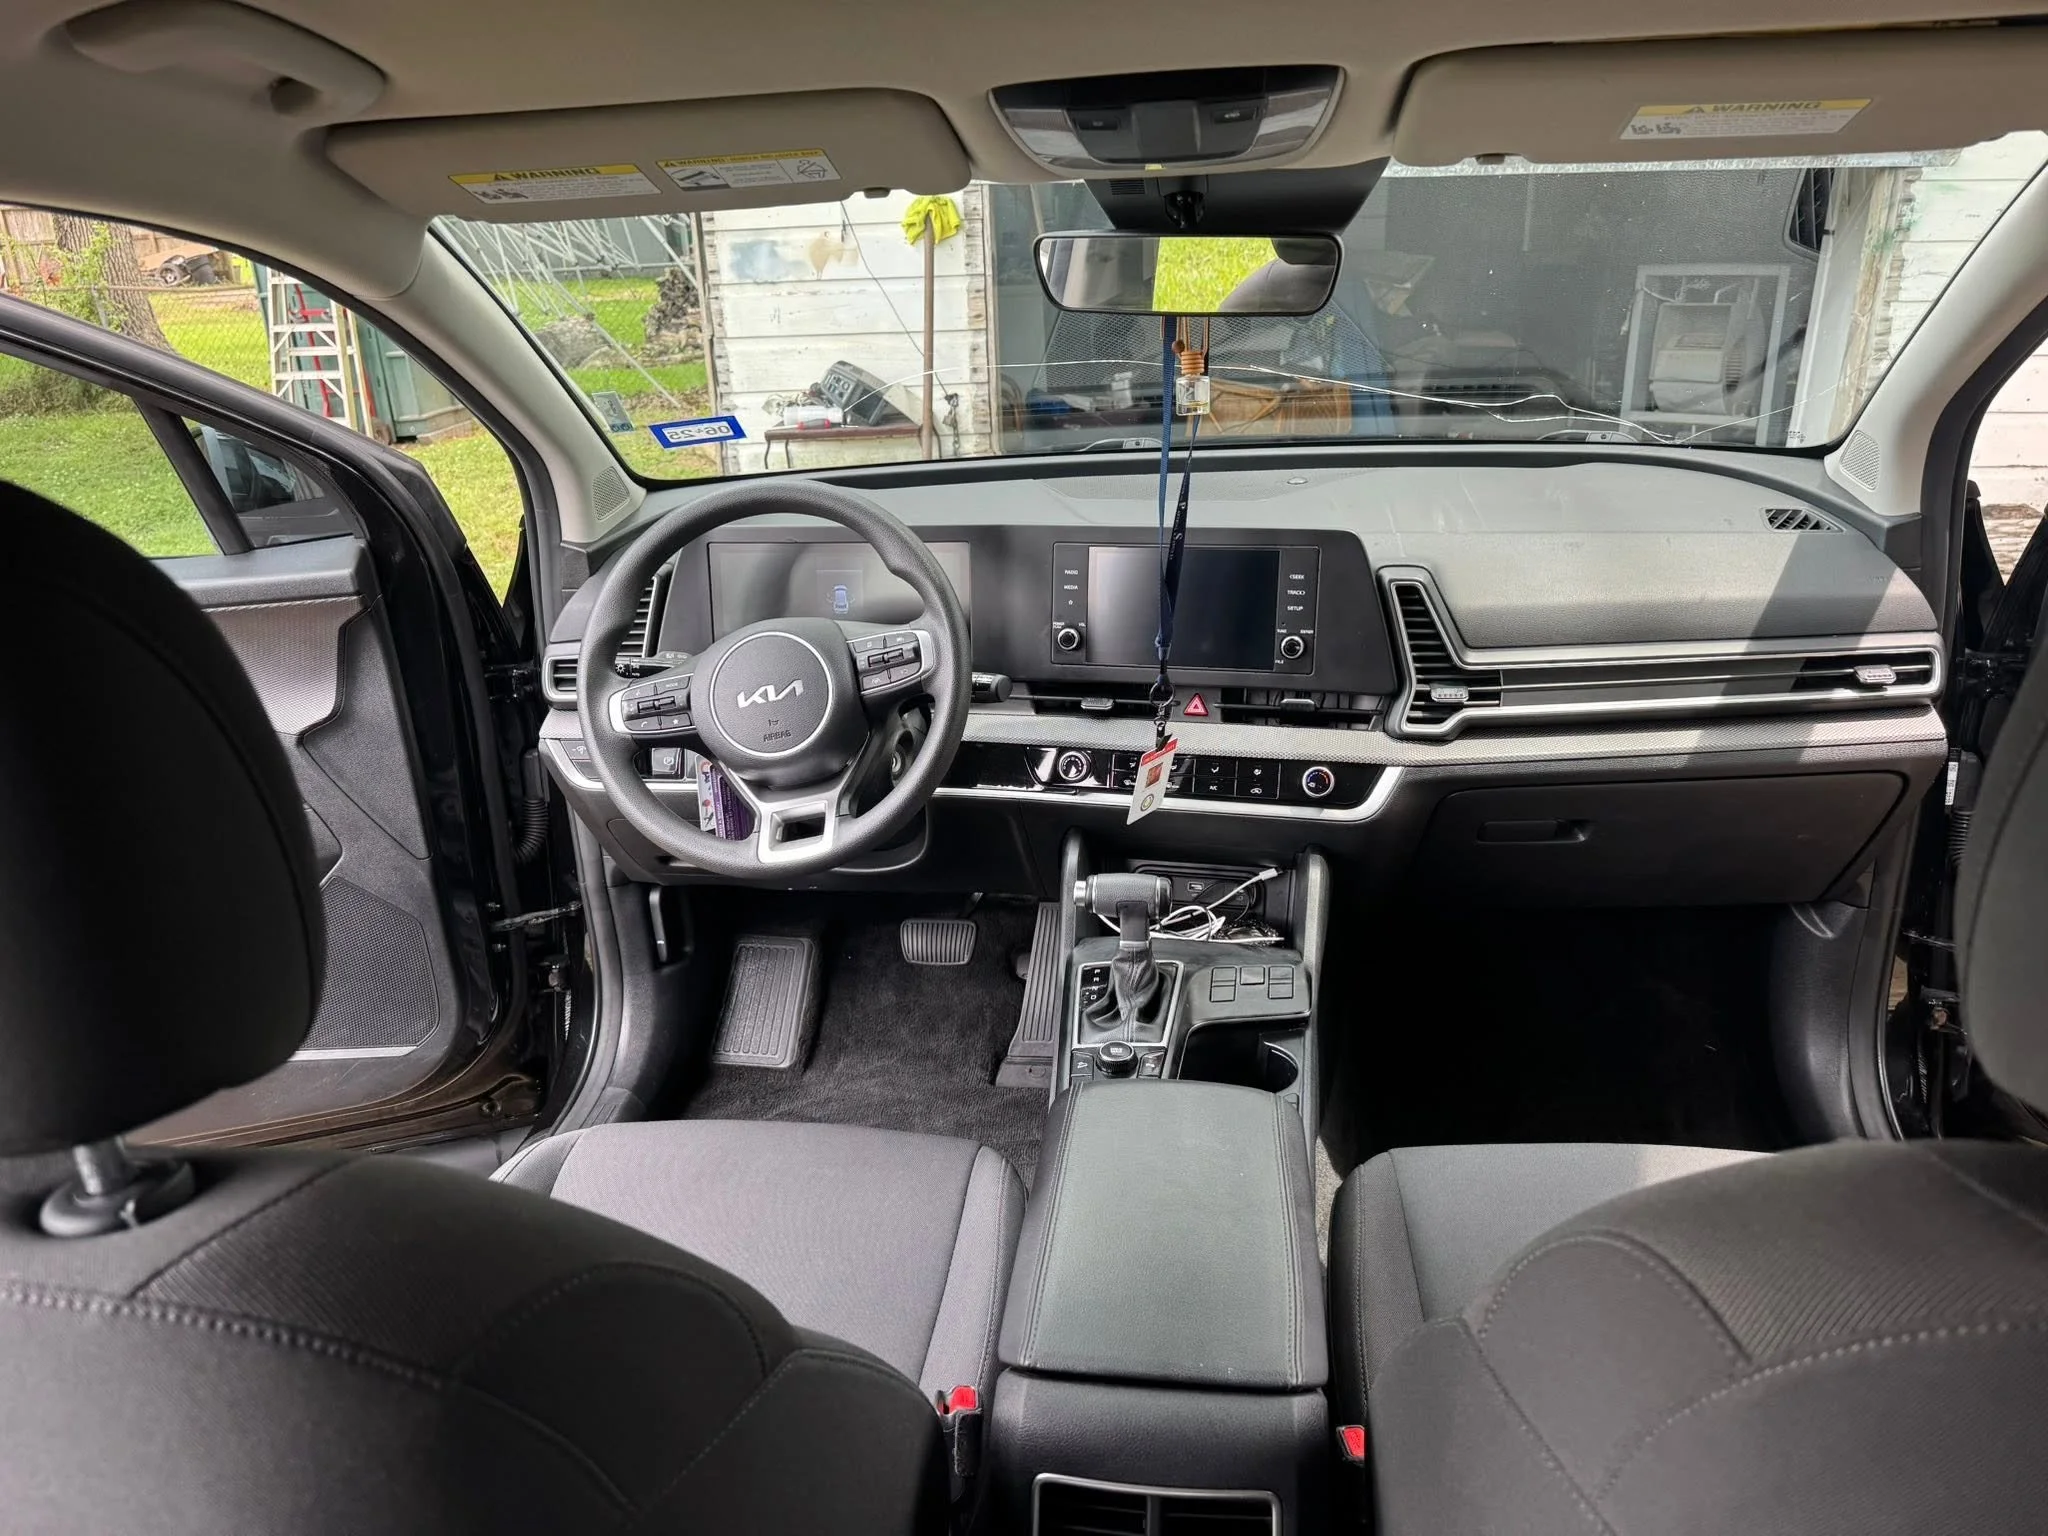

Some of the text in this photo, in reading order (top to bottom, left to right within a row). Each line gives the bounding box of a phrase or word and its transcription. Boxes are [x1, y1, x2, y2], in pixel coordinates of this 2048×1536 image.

[1712, 101, 1822, 112] WARNING
[511, 167, 600, 181] WARNING
[737, 680, 804, 708] KIA
